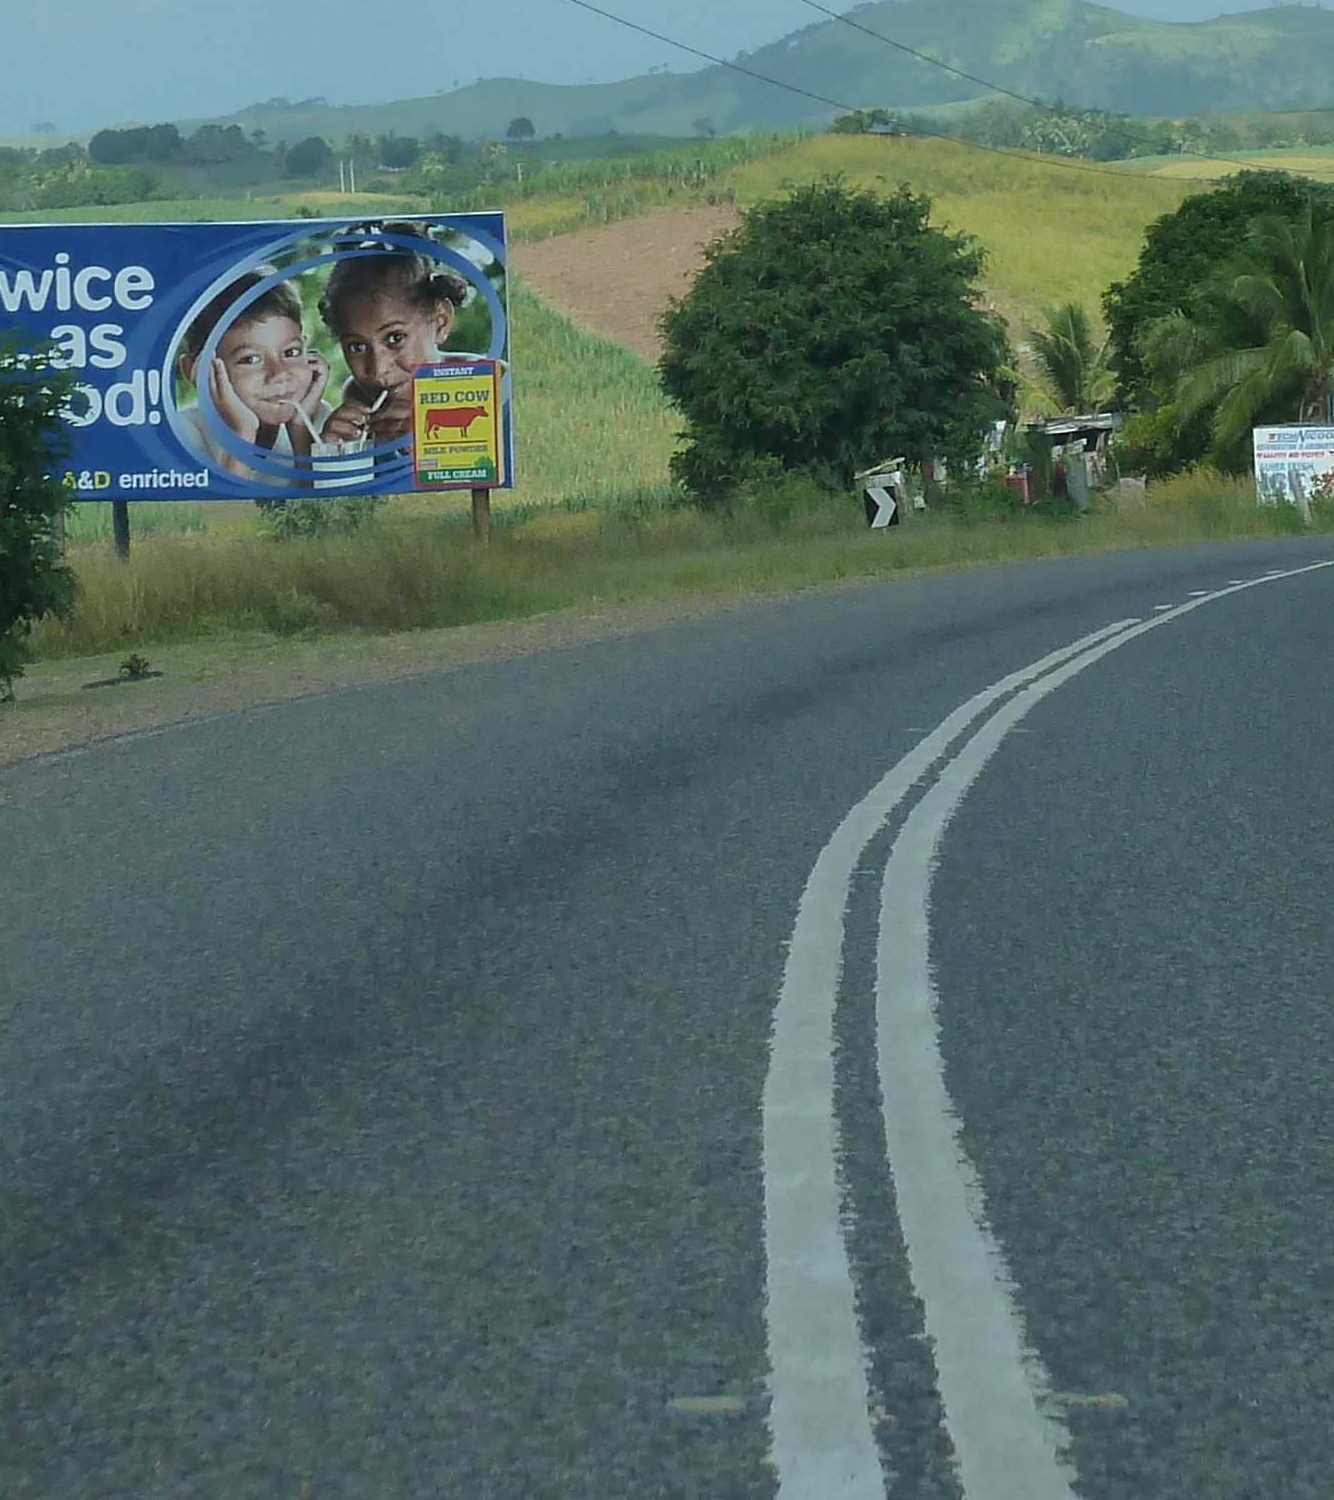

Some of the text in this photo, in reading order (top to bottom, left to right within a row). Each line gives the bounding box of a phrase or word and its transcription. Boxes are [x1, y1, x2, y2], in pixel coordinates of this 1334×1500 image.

[49, 323, 127, 369] as
[433, 367, 474, 376] INSTANT
[52, 369, 162, 428] od!
[420, 390, 490, 404] RED COW
[424, 444, 488, 455] MILK POWDER
[119, 468, 209, 489] enriched
[428, 469, 487, 480] FULL CREAM
